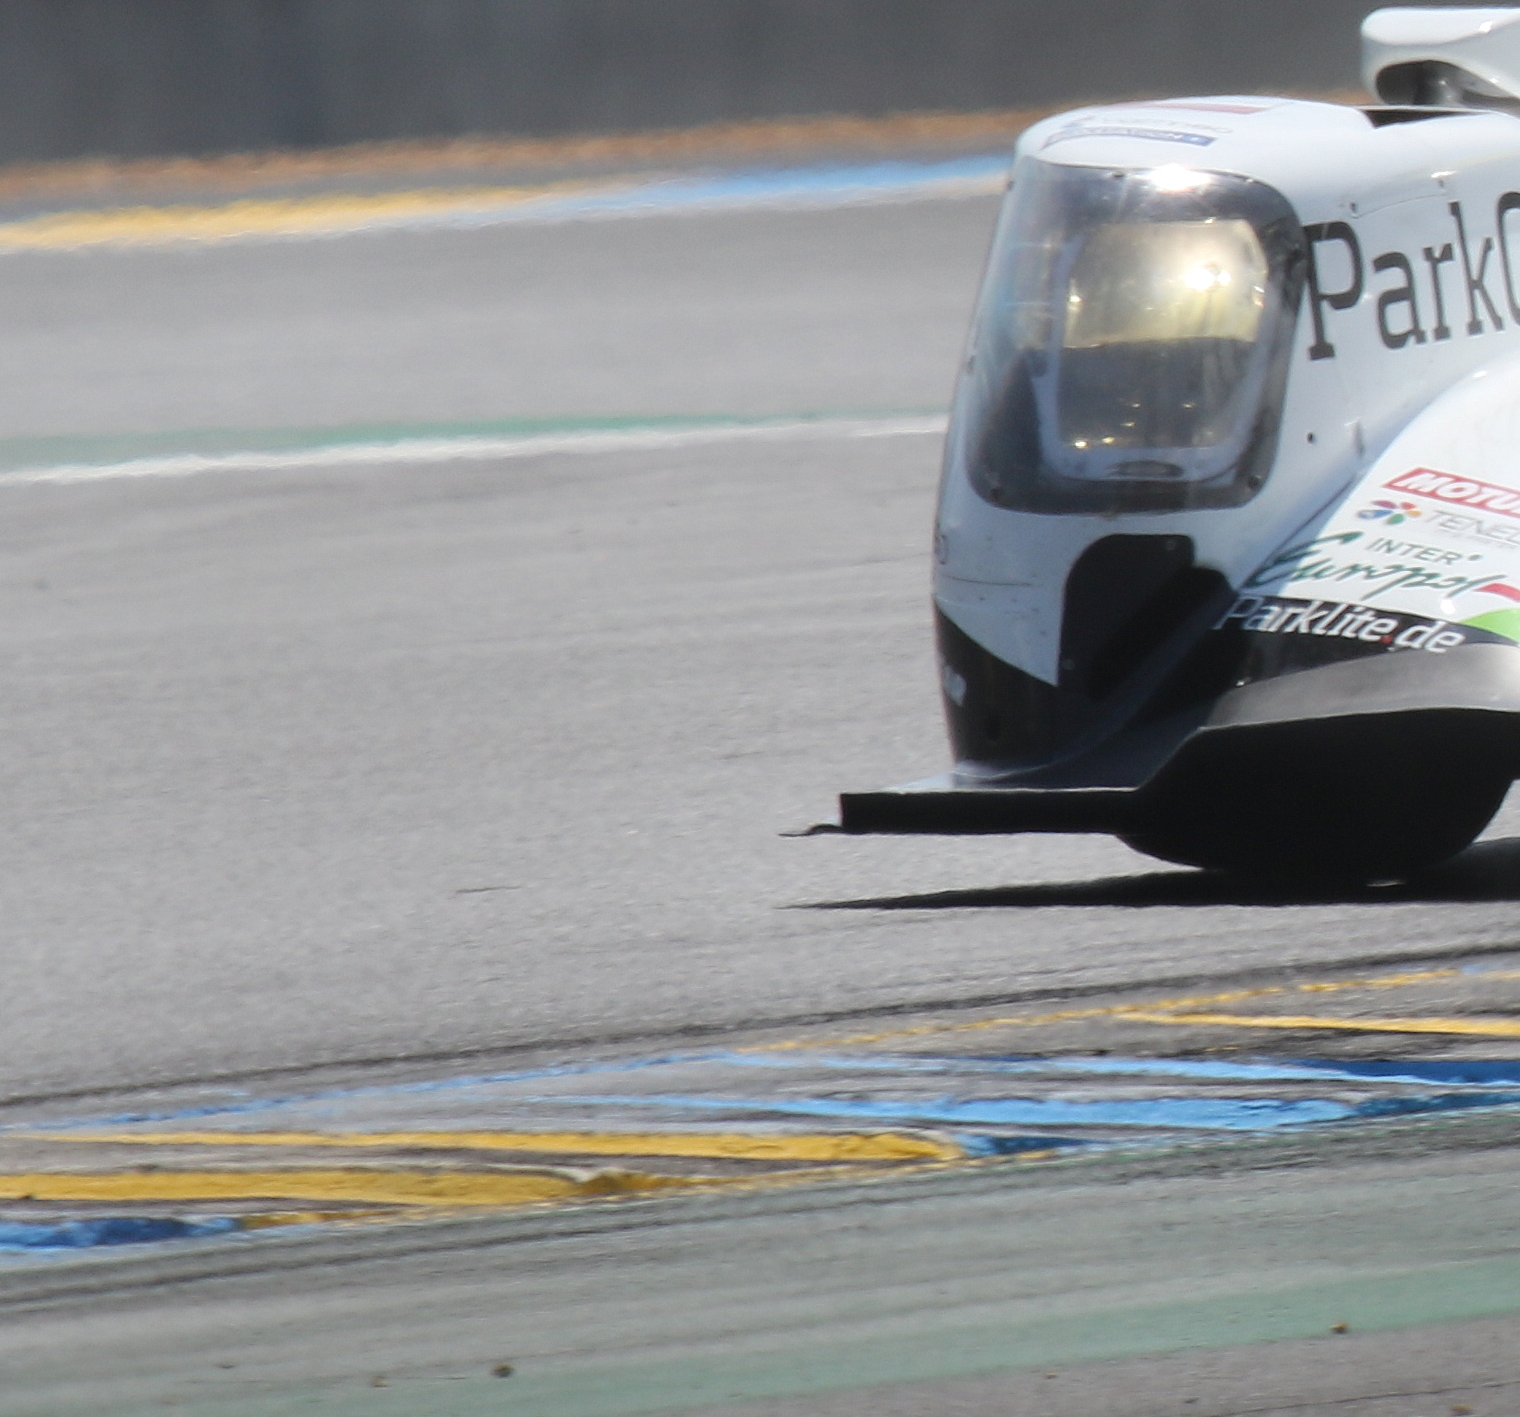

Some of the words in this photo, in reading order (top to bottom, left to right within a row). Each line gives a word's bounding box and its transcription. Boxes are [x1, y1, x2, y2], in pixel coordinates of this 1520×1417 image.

[1240, 531, 1507, 601] Europol
[1366, 537, 1465, 566] INTER
[1212, 595, 1467, 653] Parklite.de
